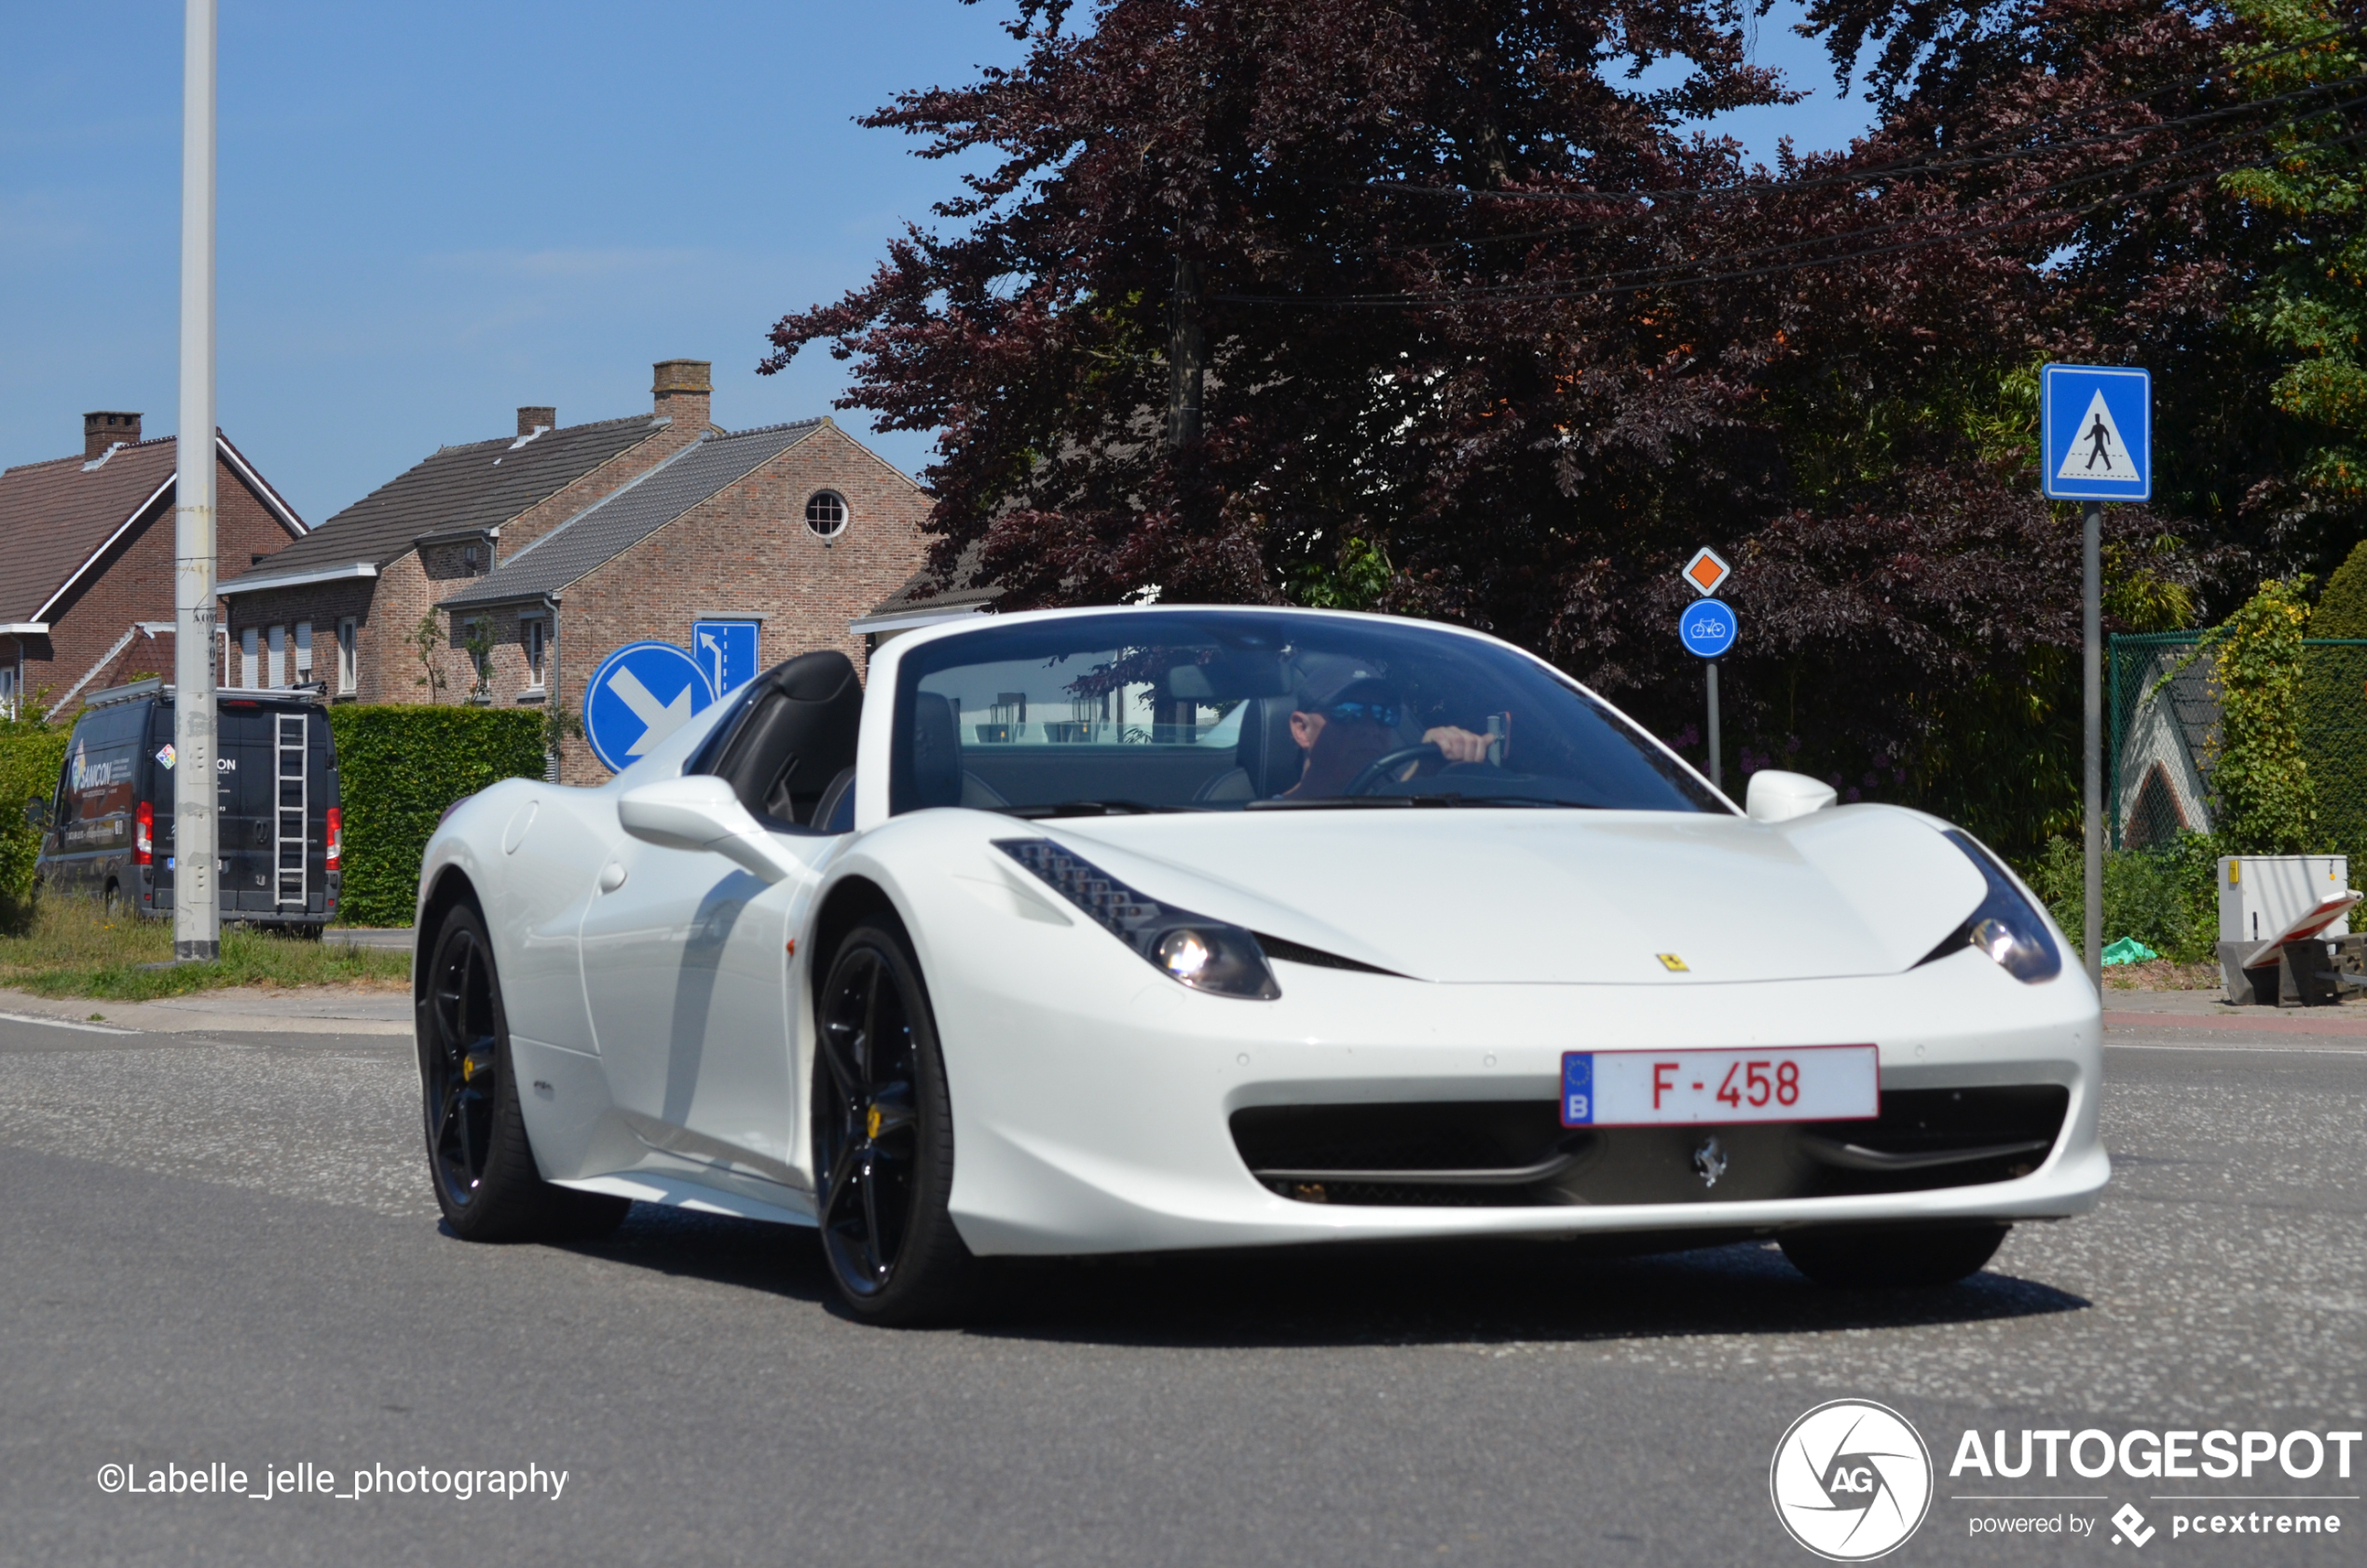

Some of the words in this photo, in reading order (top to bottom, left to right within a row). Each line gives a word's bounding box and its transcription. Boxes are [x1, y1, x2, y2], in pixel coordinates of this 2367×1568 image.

[80, 761, 113, 789] SANICON
[1653, 1060, 1800, 1110] F-458
[1569, 1096, 1588, 1118] B
